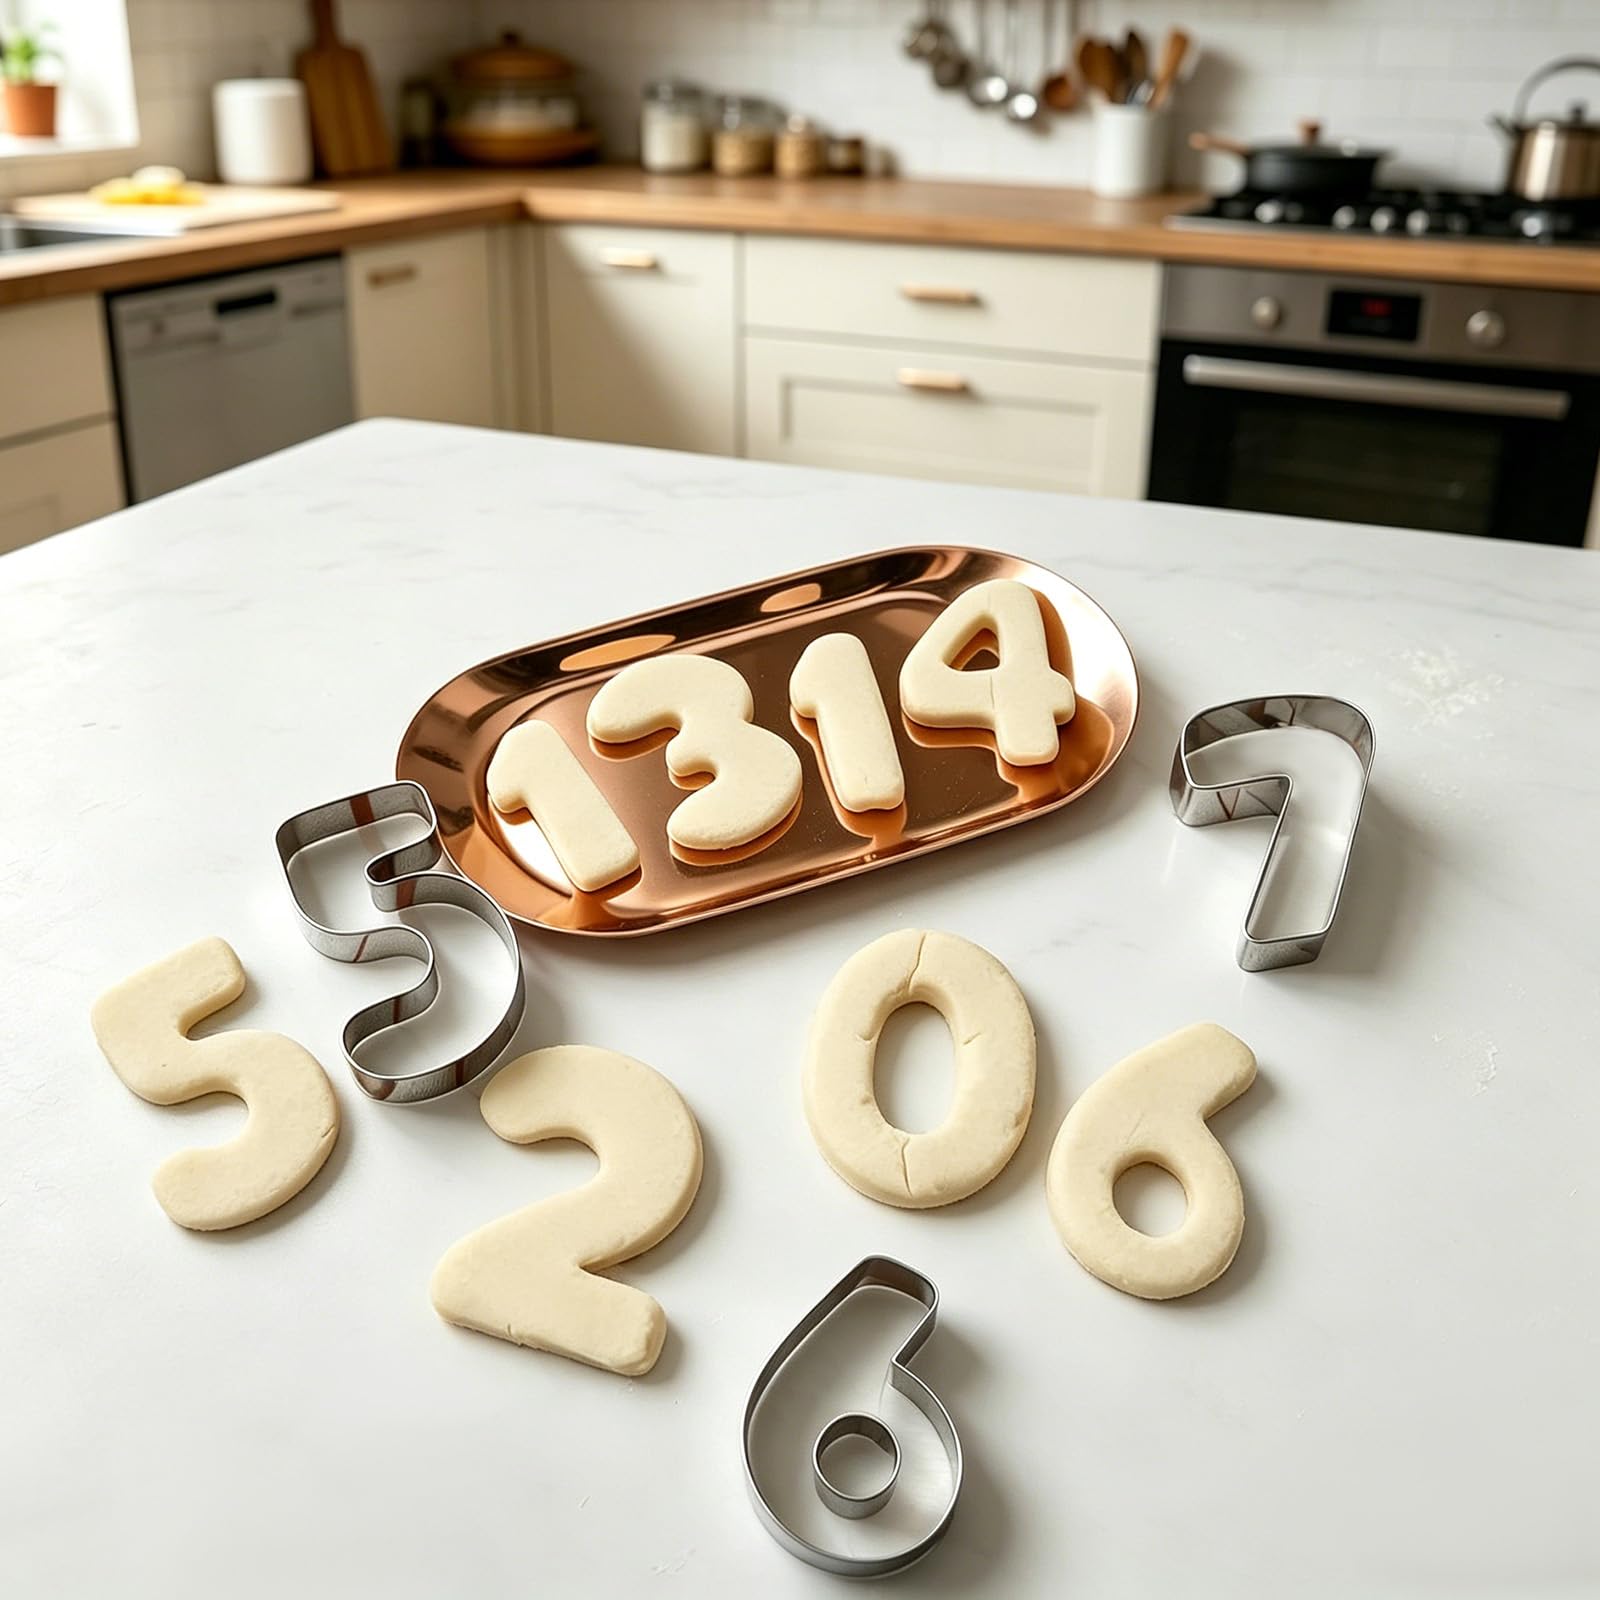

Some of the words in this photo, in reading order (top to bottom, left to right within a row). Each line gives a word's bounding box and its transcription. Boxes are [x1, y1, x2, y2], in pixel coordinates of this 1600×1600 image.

[275, 780, 525, 1104] 5
[1169, 694, 1376, 972] 7
[91, 936, 340, 1230] 5
[430, 1044, 704, 1377] 2
[1046, 1022, 1257, 1300] 6
[743, 1255, 963, 1579] 6
